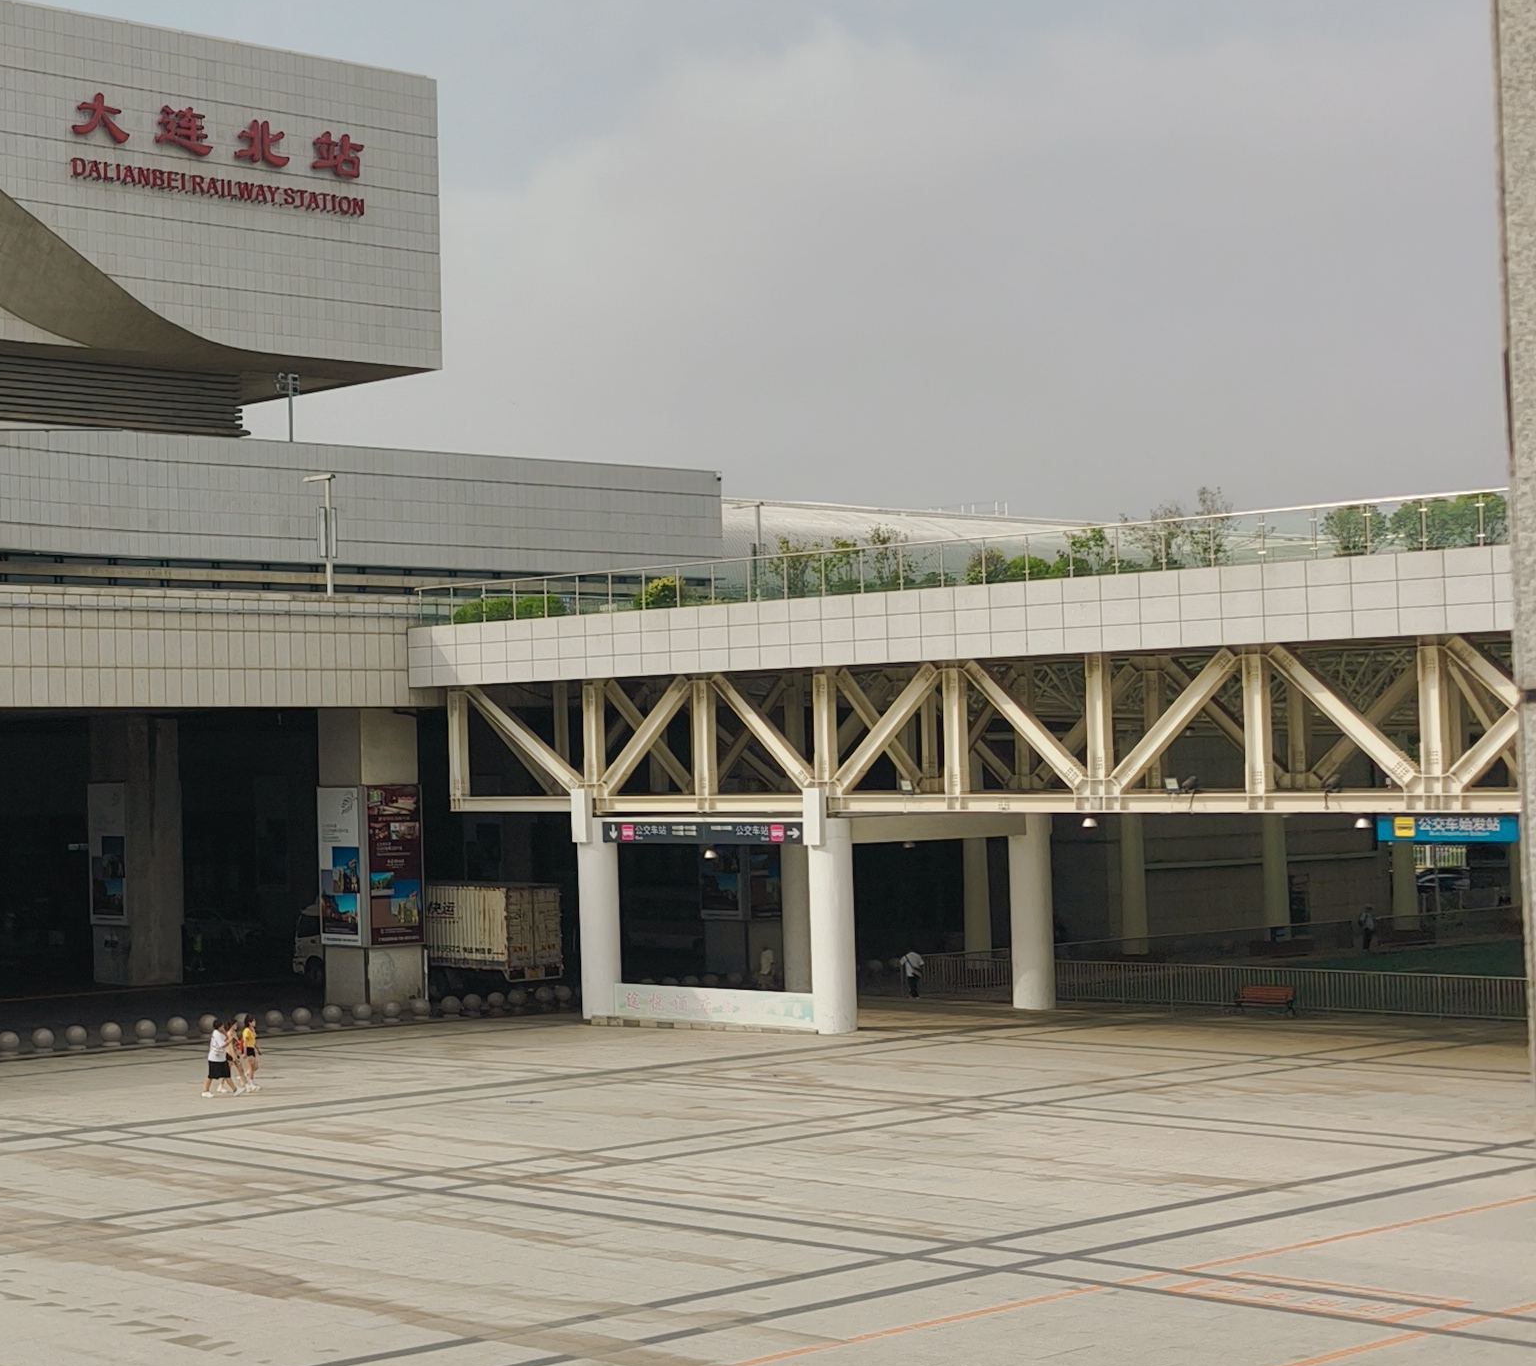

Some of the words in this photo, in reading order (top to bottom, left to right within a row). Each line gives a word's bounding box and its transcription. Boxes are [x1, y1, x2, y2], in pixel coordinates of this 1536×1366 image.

[71, 92, 364, 178] 大连北站
[70, 157, 186, 193] DALIANBEI
[189, 173, 279, 205] RAILWAY
[283, 187, 365, 217] STATION
[635, 825, 667, 835] 公交车站
[735, 825, 769, 836] 公交车站
[1418, 816, 1501, 832] 公交车始发站
